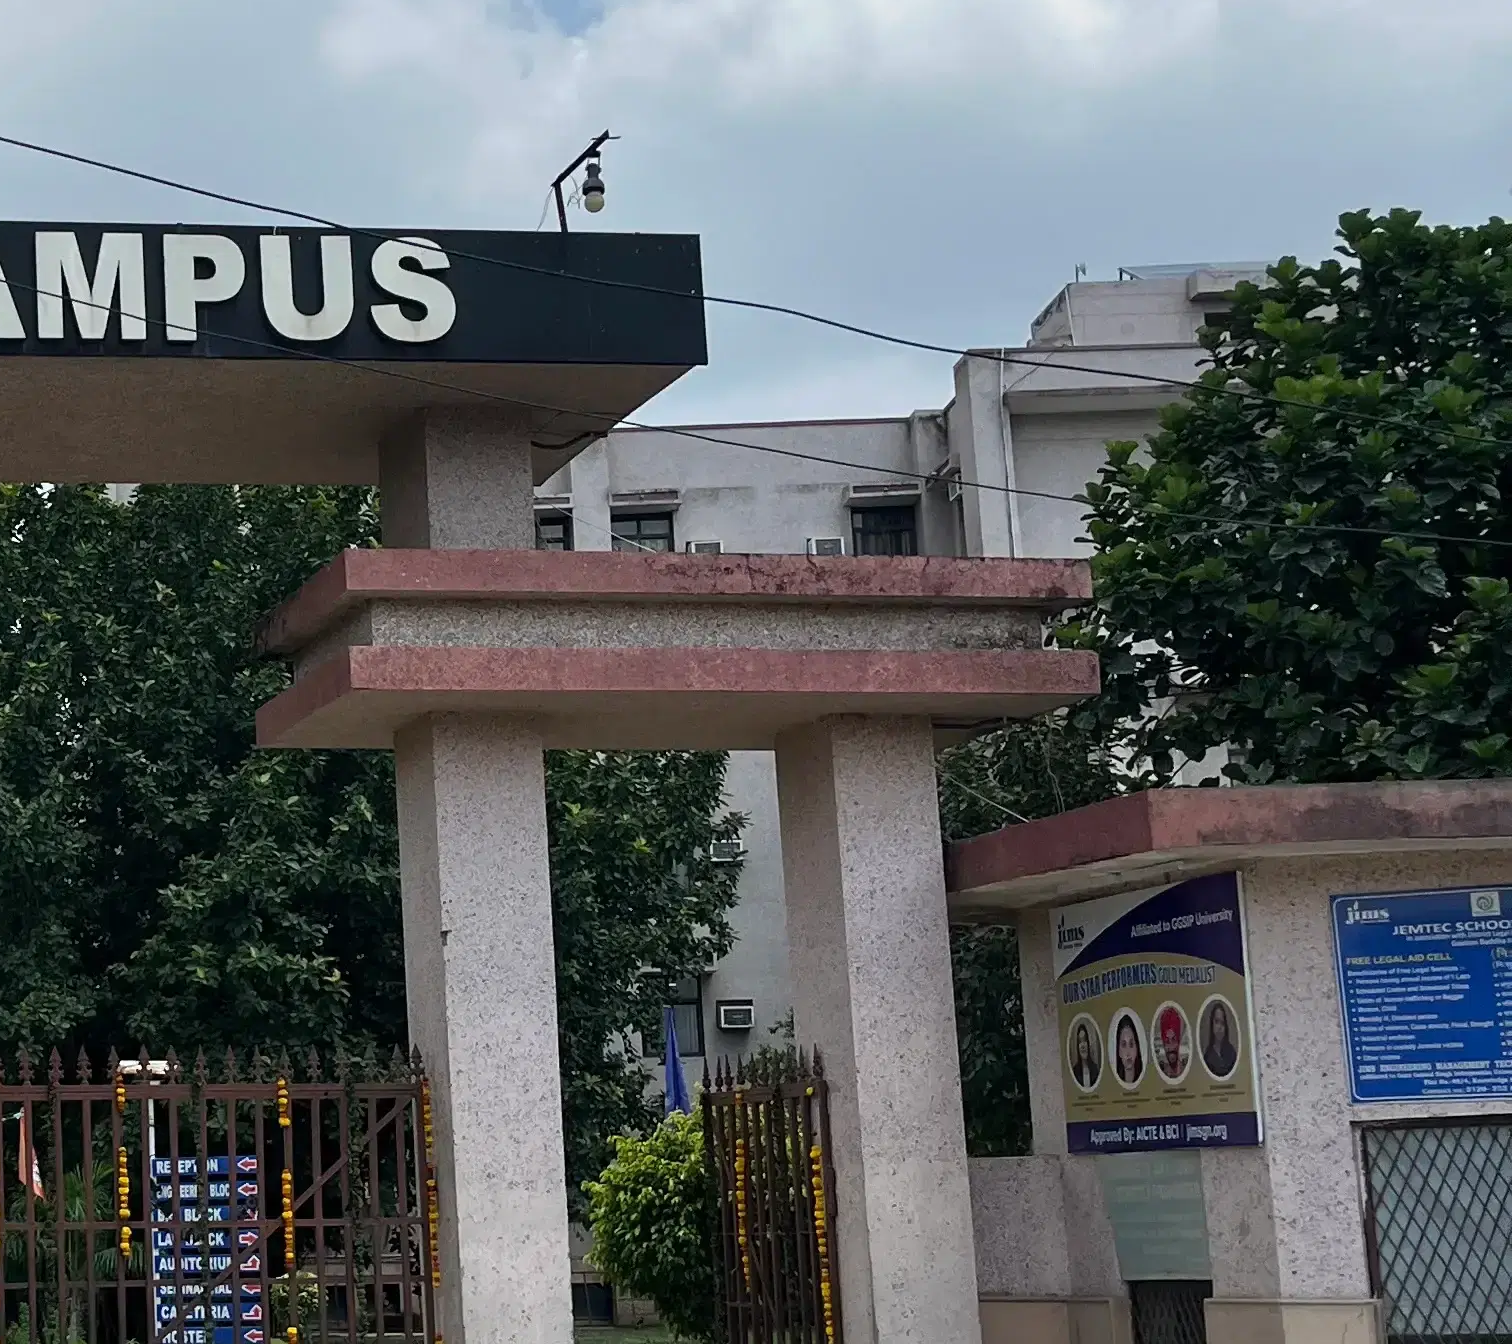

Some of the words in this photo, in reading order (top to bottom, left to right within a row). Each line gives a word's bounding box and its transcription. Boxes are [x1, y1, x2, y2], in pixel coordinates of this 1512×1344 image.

[1163, 921, 1171, 932] to
[1195, 908, 1234, 926] University
[1392, 922, 1452, 935] JEMTEC
[1455, 919, 1512, 932] SCHOO
[1346, 957, 1371, 965] FREE
[1373, 955, 1406, 964] LEGAL
[1408, 954, 1424, 962] AID
[1427, 953, 1452, 961] CELL
[1062, 981, 1080, 1005] OUR
[1080, 975, 1101, 1000] STAR
[1102, 962, 1157, 993] PERFORMERS
[1158, 965, 1177, 985] GOLD
[1178, 964, 1216, 985] MEDALIST
[1136, 1125, 1158, 1141] AICTE
[156, 1159, 219, 1174] REEPTN
[209, 1183, 231, 1197] BLOC
[184, 1208, 223, 1222] BLCK
[157, 1232, 174, 1246] LA
